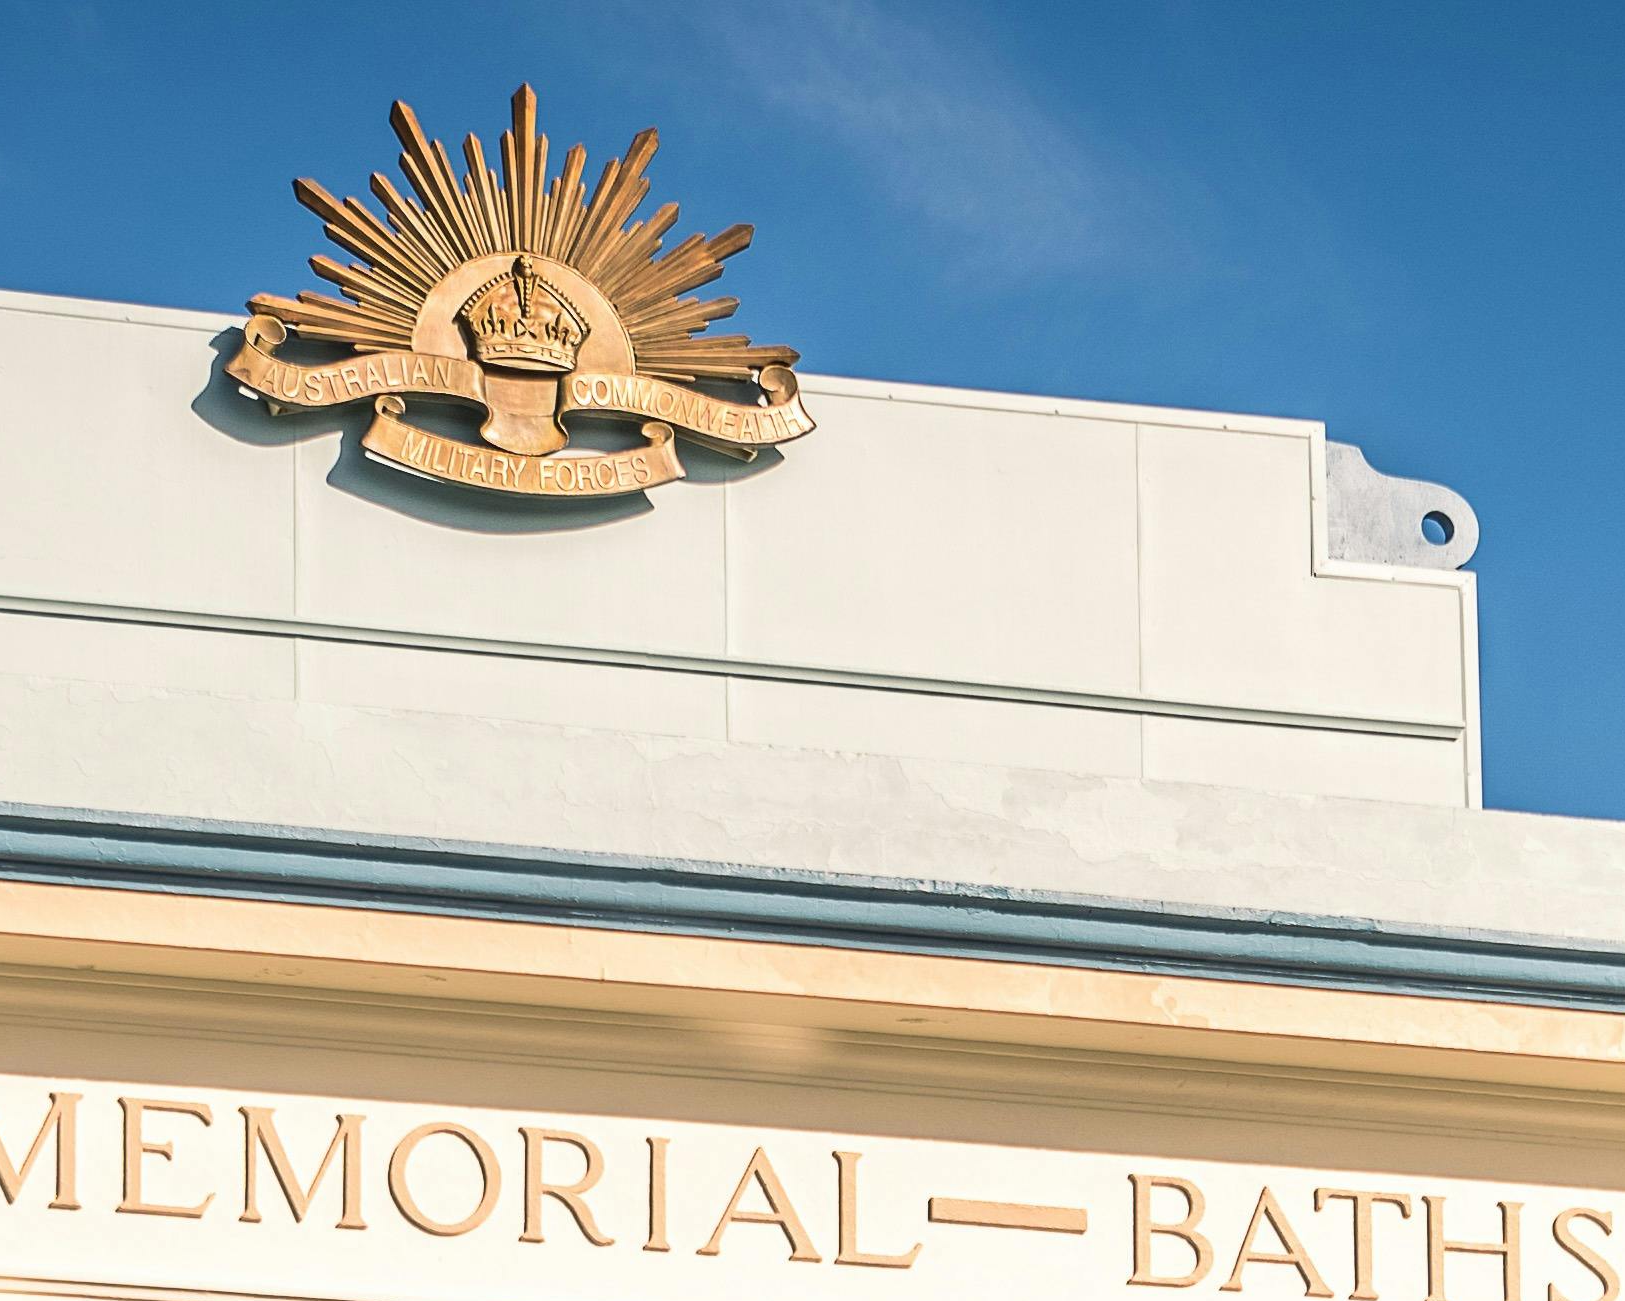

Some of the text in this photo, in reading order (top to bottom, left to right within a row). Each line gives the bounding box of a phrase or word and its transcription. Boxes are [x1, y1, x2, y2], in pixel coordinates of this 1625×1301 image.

[263, 352, 806, 438] AUSTRALIAN COMMONWEALTH
[400, 431, 652, 492] MILITARY FORCES
